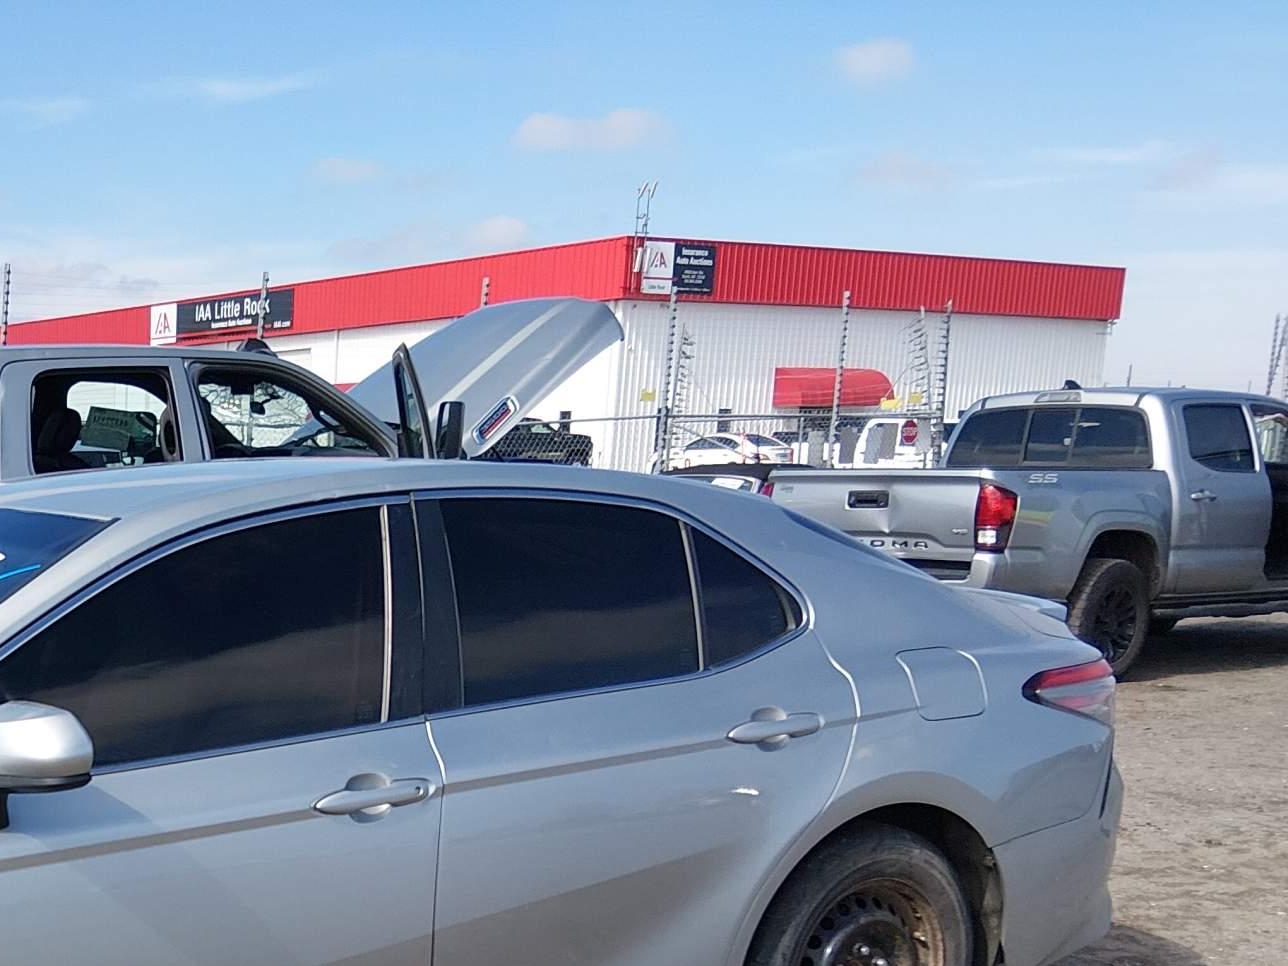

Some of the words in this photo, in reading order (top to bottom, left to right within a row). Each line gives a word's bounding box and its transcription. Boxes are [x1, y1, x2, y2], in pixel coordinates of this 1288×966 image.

[195, 302, 212, 322] IAA
[215, 299, 240, 319] Little
[903, 426, 917, 436] STOP
